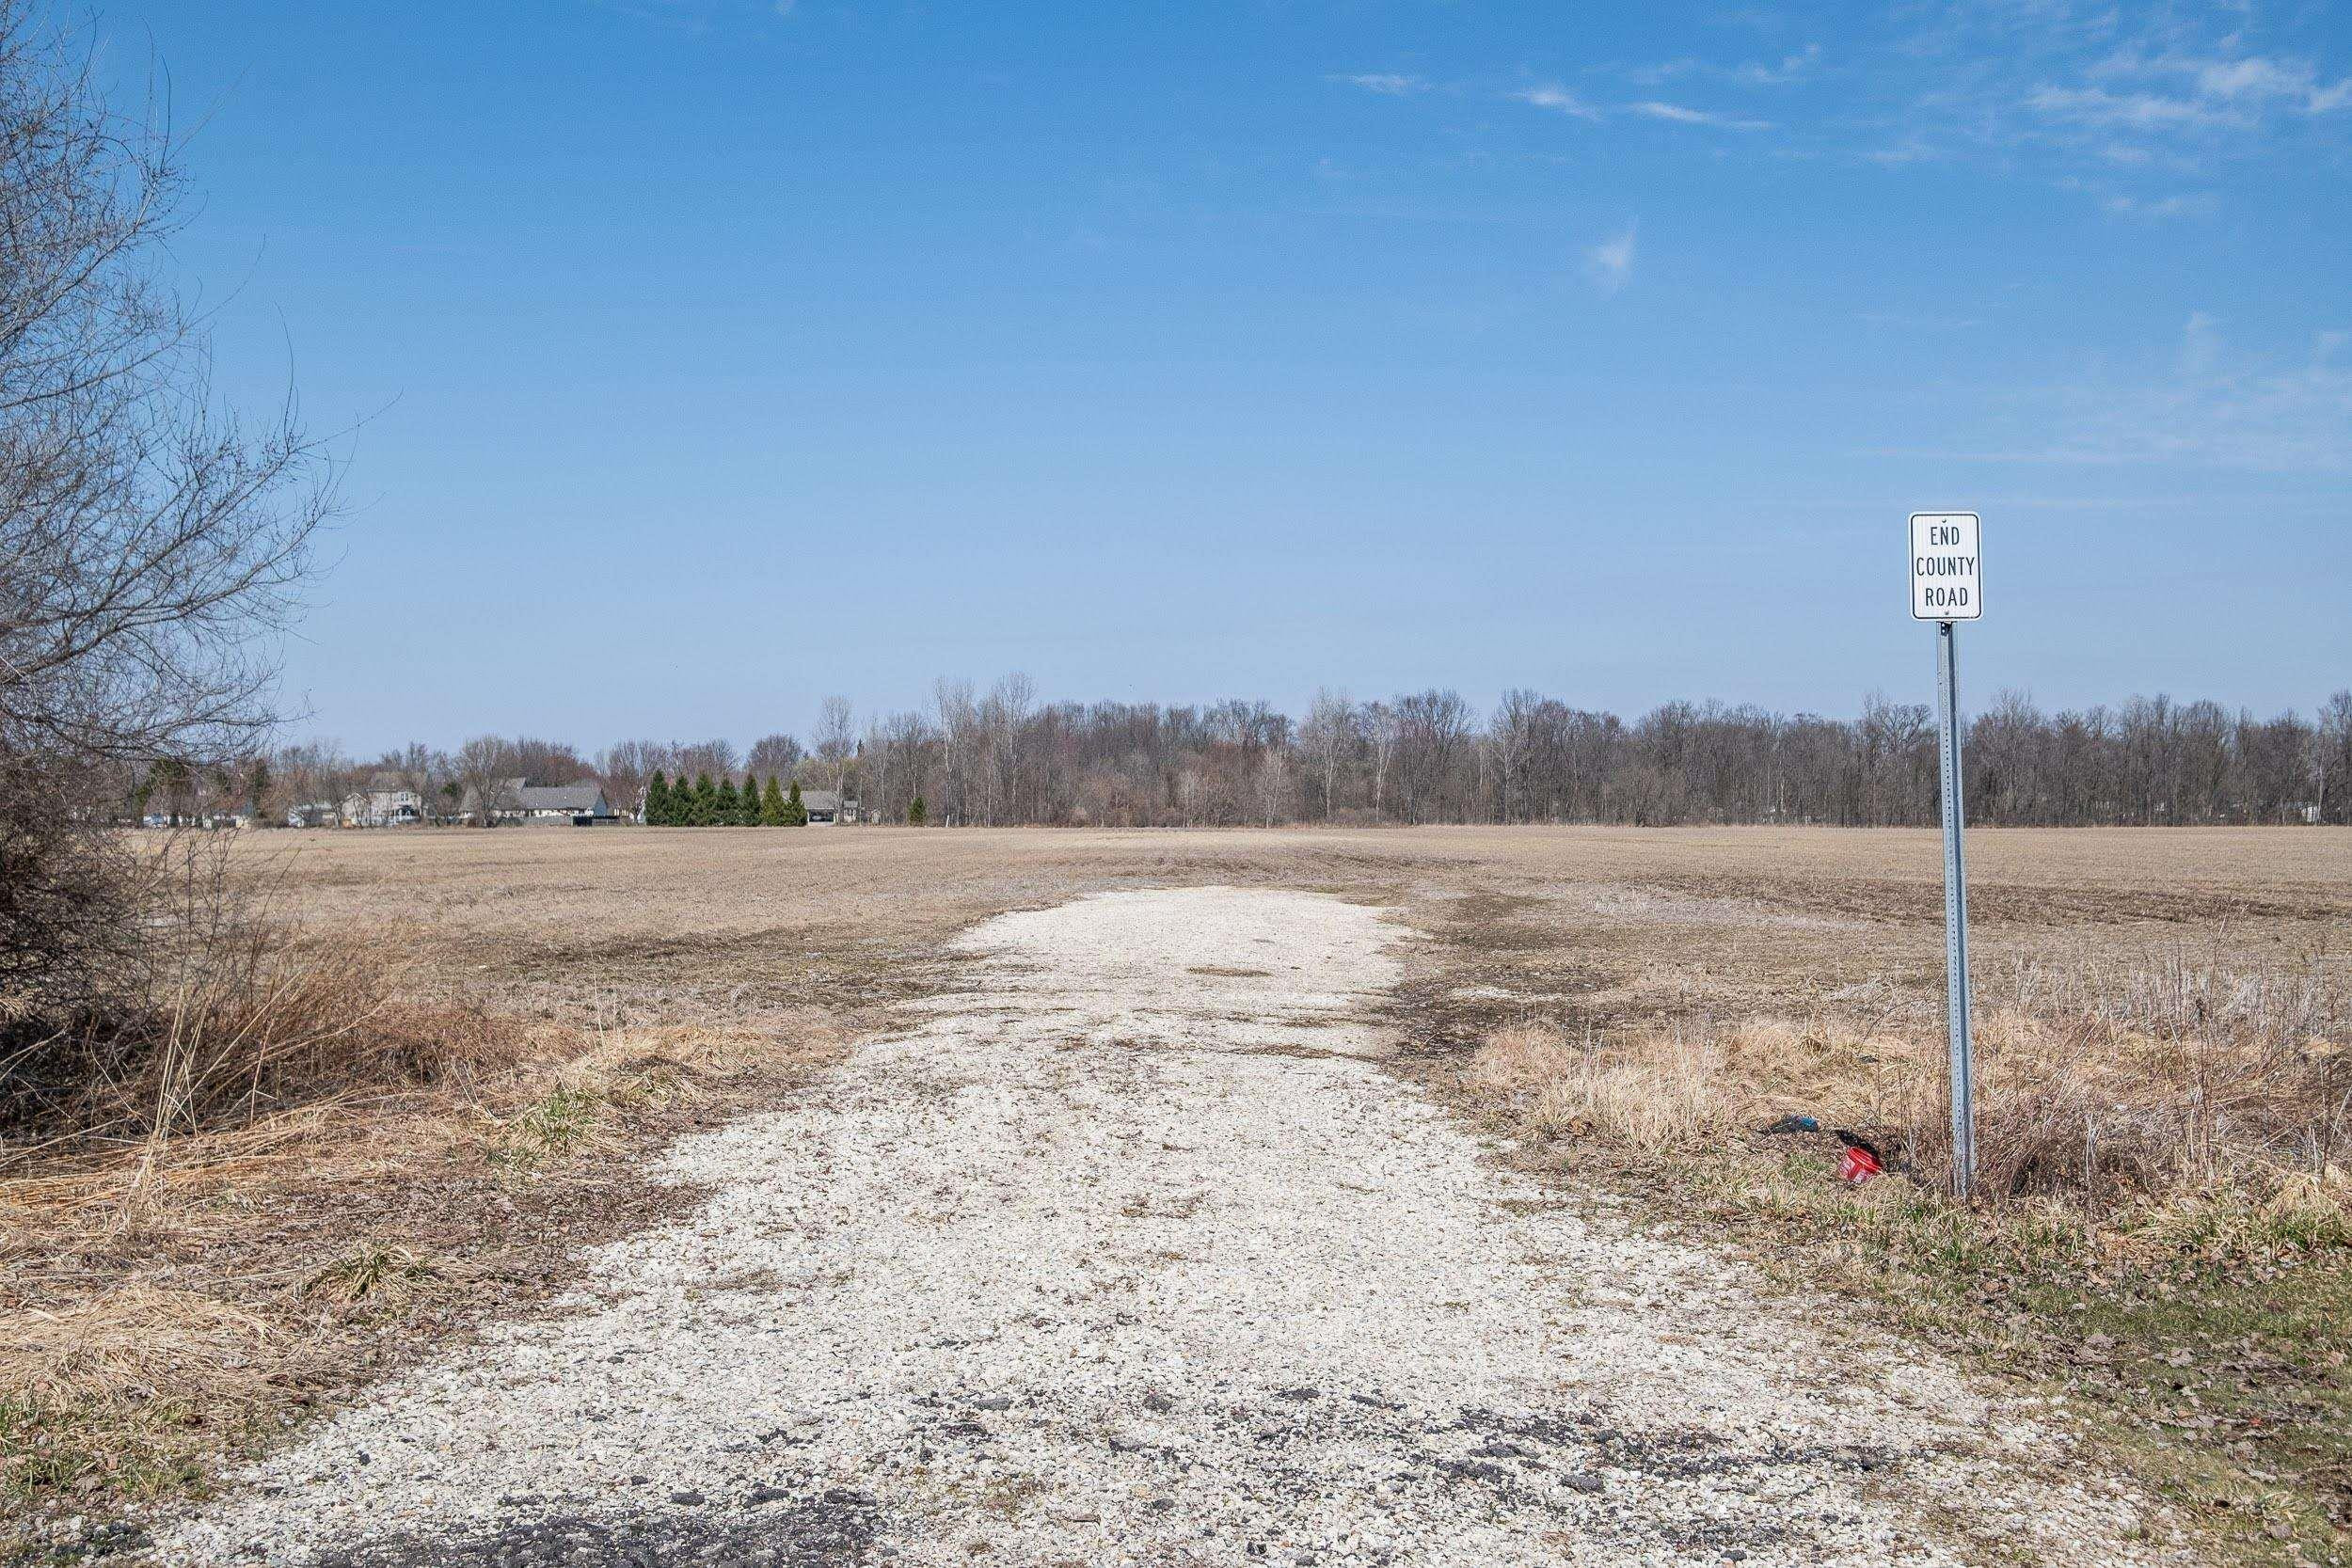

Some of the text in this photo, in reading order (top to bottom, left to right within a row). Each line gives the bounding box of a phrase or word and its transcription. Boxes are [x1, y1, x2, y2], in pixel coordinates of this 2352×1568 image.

[1931, 527, 1960, 545] END
[1916, 557, 1975, 576] COUNTY
[1926, 588, 1968, 606] ROAD
